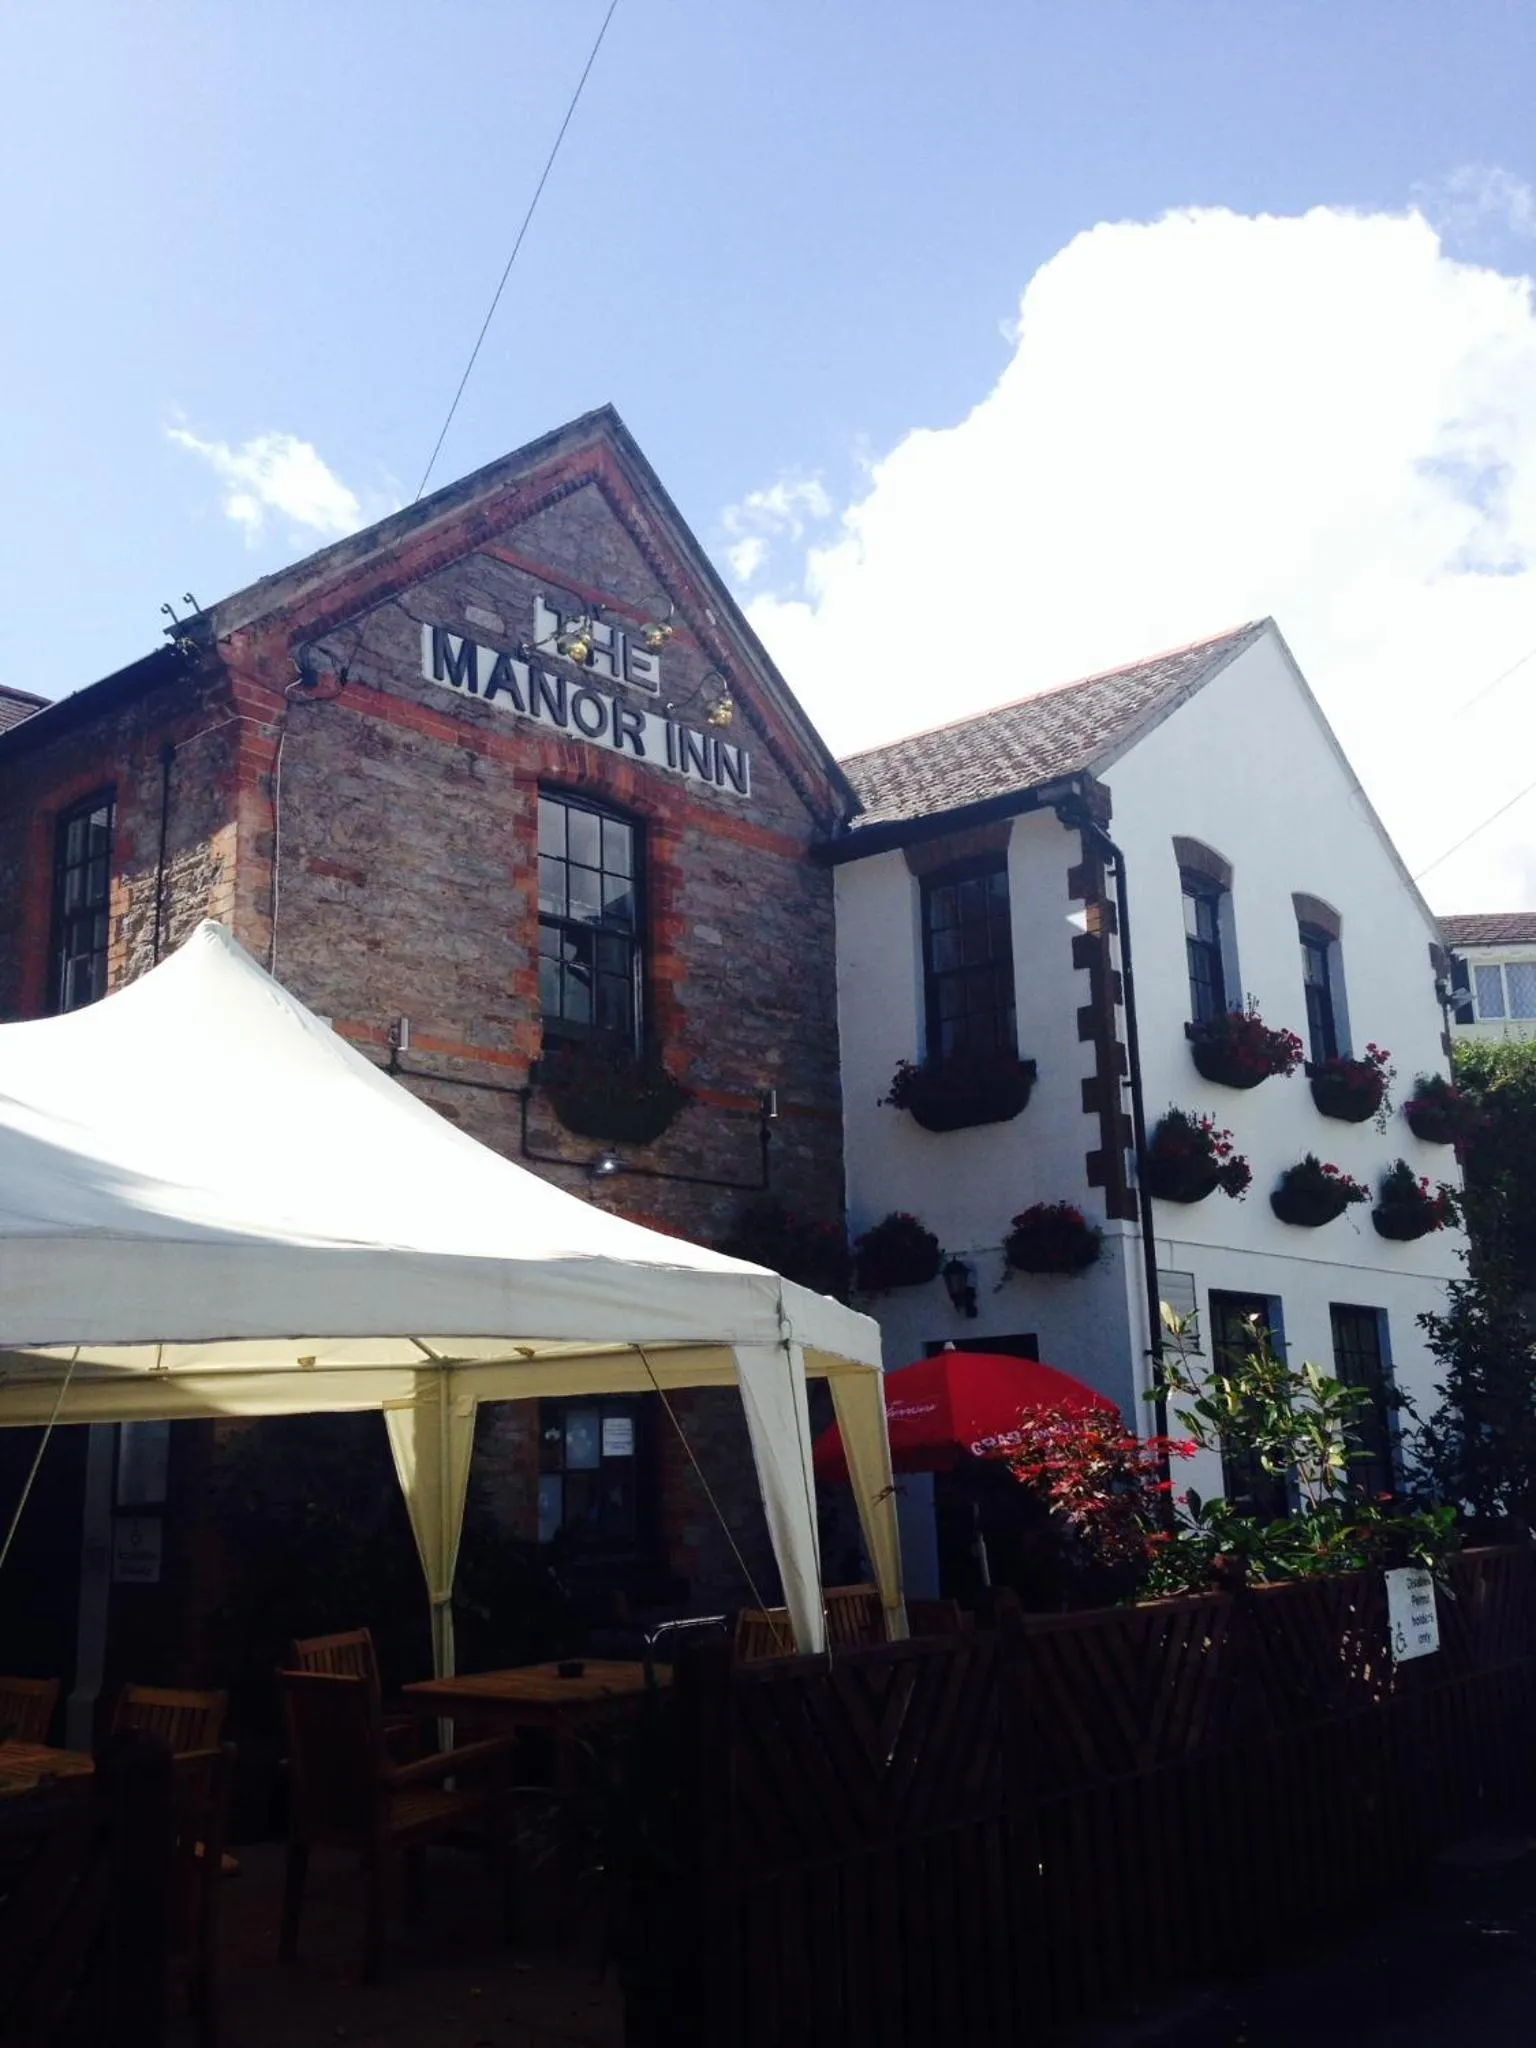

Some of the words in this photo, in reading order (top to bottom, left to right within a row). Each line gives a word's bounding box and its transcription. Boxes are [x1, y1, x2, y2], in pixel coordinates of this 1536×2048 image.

[432, 626, 646, 757] MANOR
[665, 719, 748, 795] INN
[544, 597, 658, 692] THE
